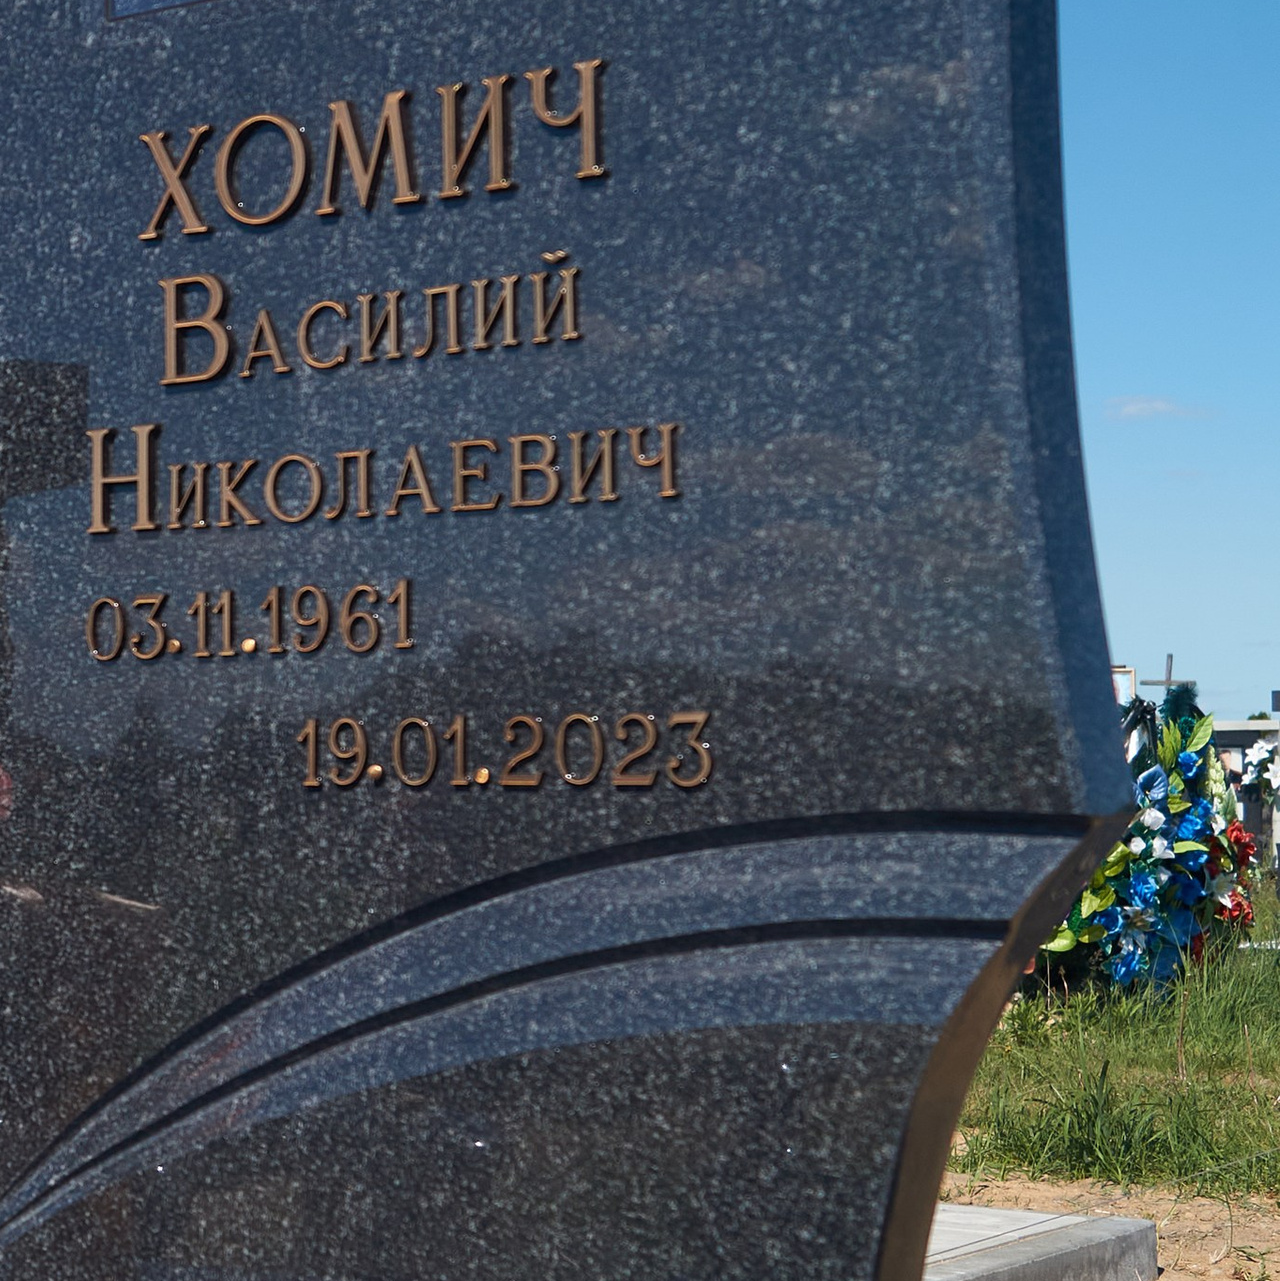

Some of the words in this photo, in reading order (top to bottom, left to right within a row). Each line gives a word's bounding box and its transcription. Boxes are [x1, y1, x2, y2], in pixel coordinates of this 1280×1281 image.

[138, 59, 608, 241] ХОМИЧ
[85, 578, 416, 662] 03.11.1961
[295, 711, 714, 789] 19.01.2023
